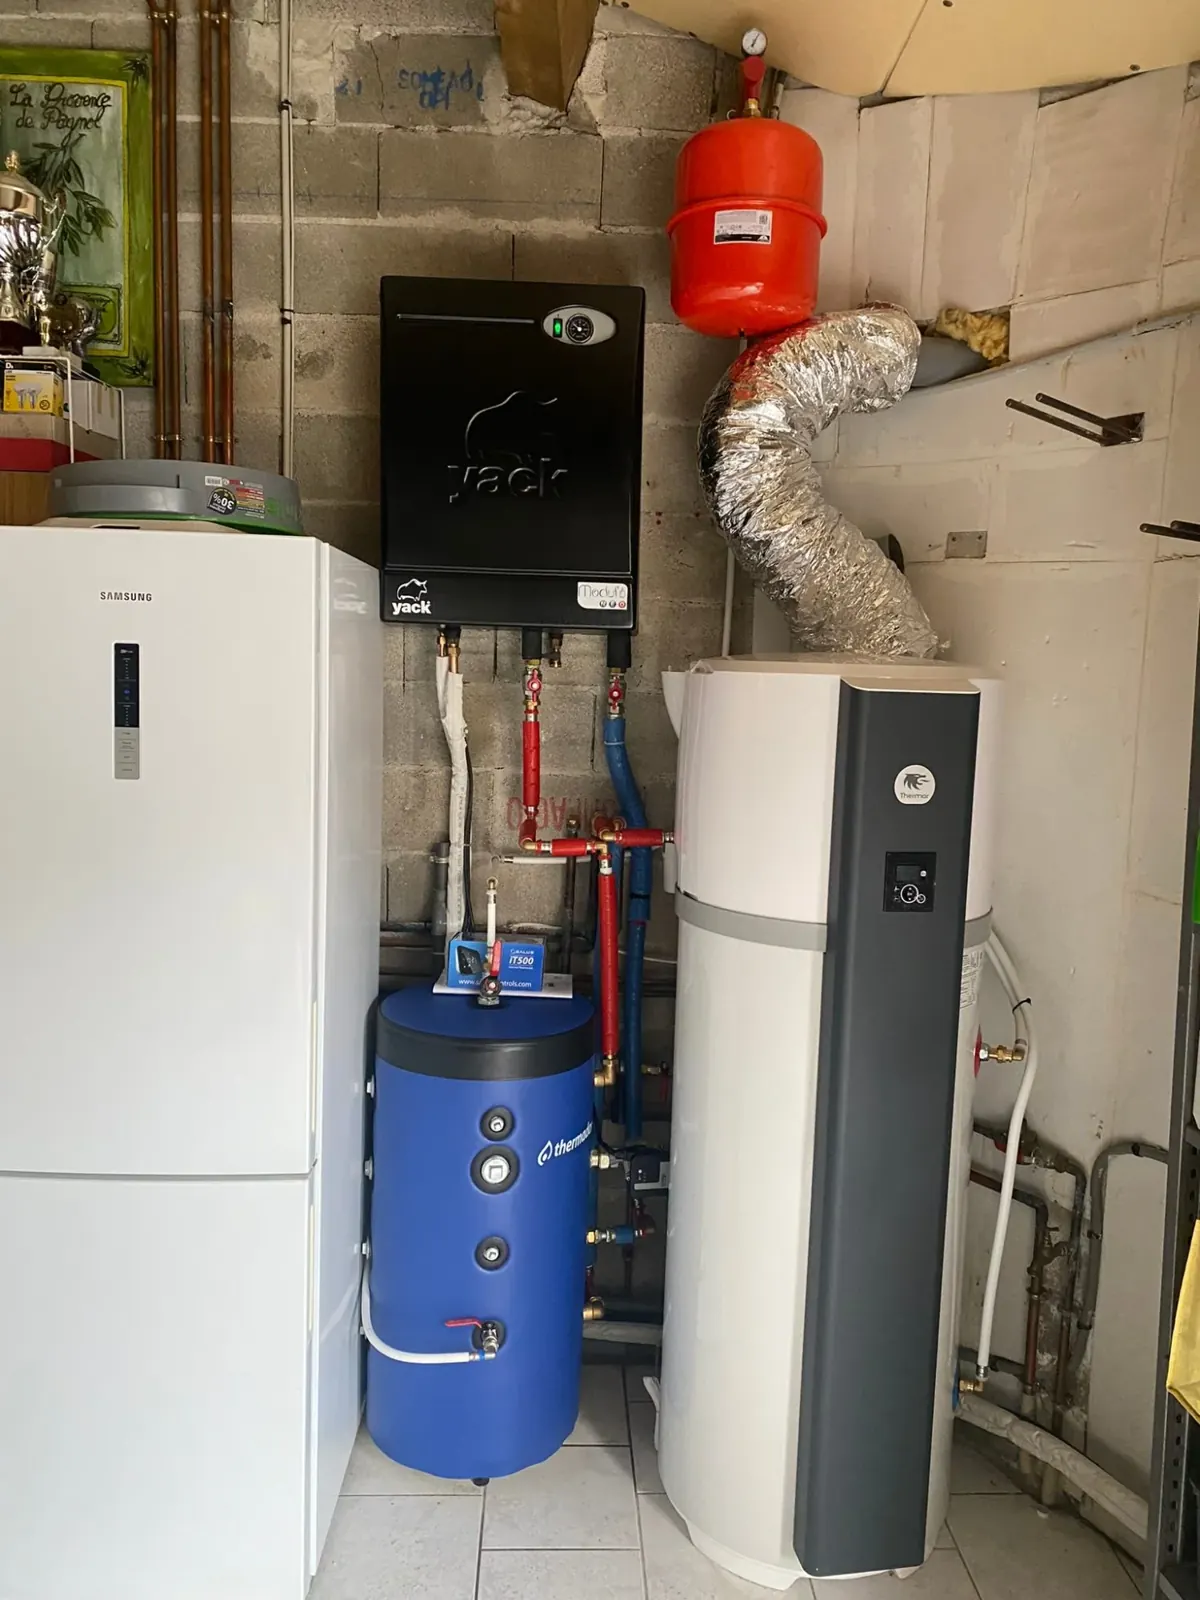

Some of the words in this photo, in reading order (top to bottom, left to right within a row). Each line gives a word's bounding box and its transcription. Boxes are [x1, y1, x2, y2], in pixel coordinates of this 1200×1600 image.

[9, 82, 34, 108] La
[40, 82, 112, 109] Provence
[15, 107, 35, 129] de
[40, 105, 106, 145] Pagnol
[447, 457, 569, 504] yack
[213, 493, 235, 510] 30%
[100, 591, 152, 602] SAMSUNG
[391, 600, 432, 616] yack
[508, 955, 534, 965] IT500
[458, 979, 532, 988] www.santrols.com
